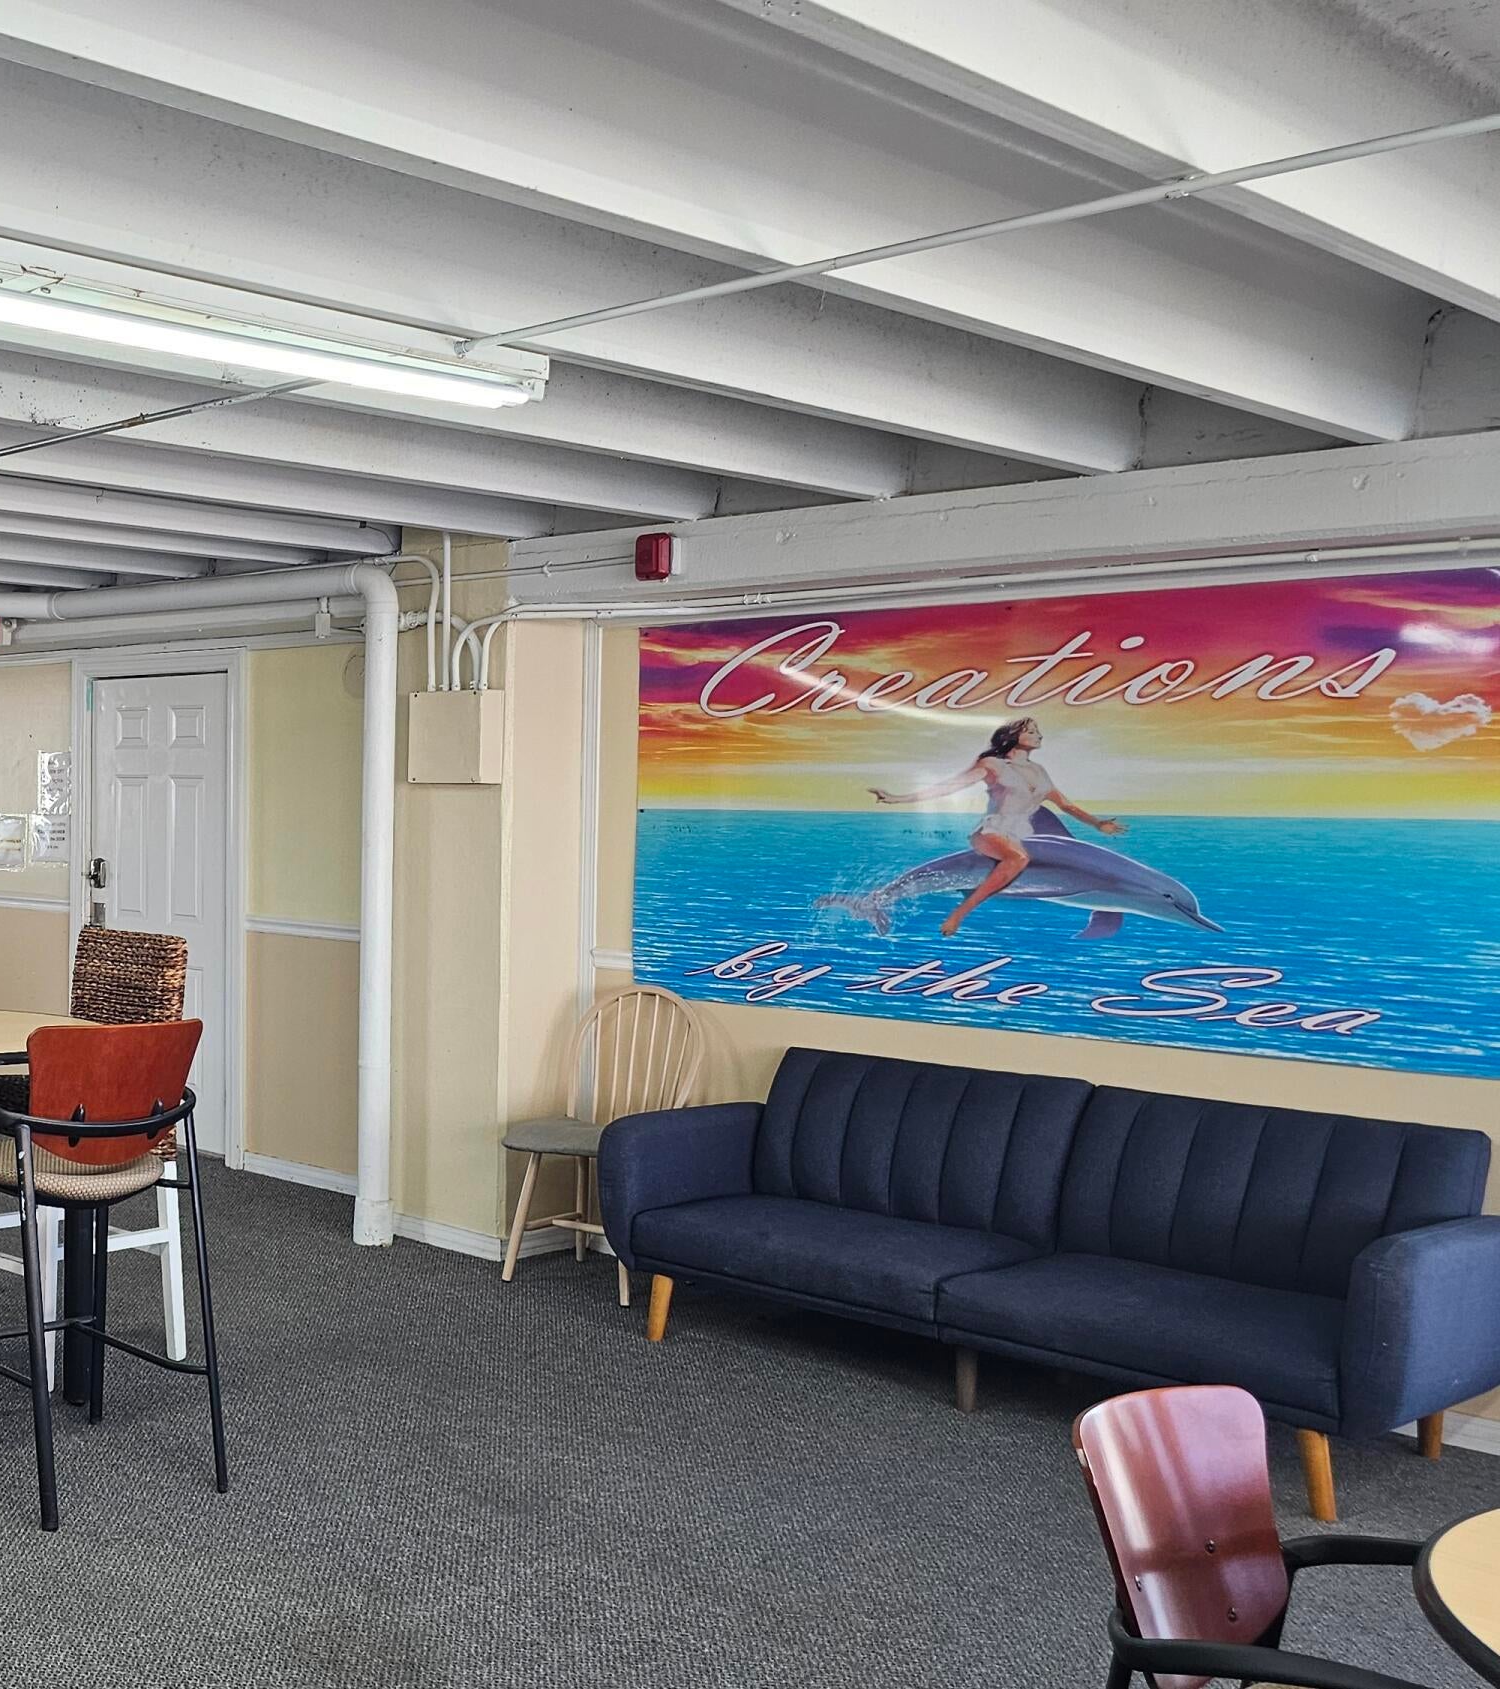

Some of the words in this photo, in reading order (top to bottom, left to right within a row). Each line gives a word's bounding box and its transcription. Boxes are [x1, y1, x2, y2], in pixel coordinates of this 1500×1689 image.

[699, 621, 1397, 719] Creations
[686, 941, 832, 1002] by
[847, 955, 1049, 1006] the
[1091, 966, 1384, 1036] Sea
